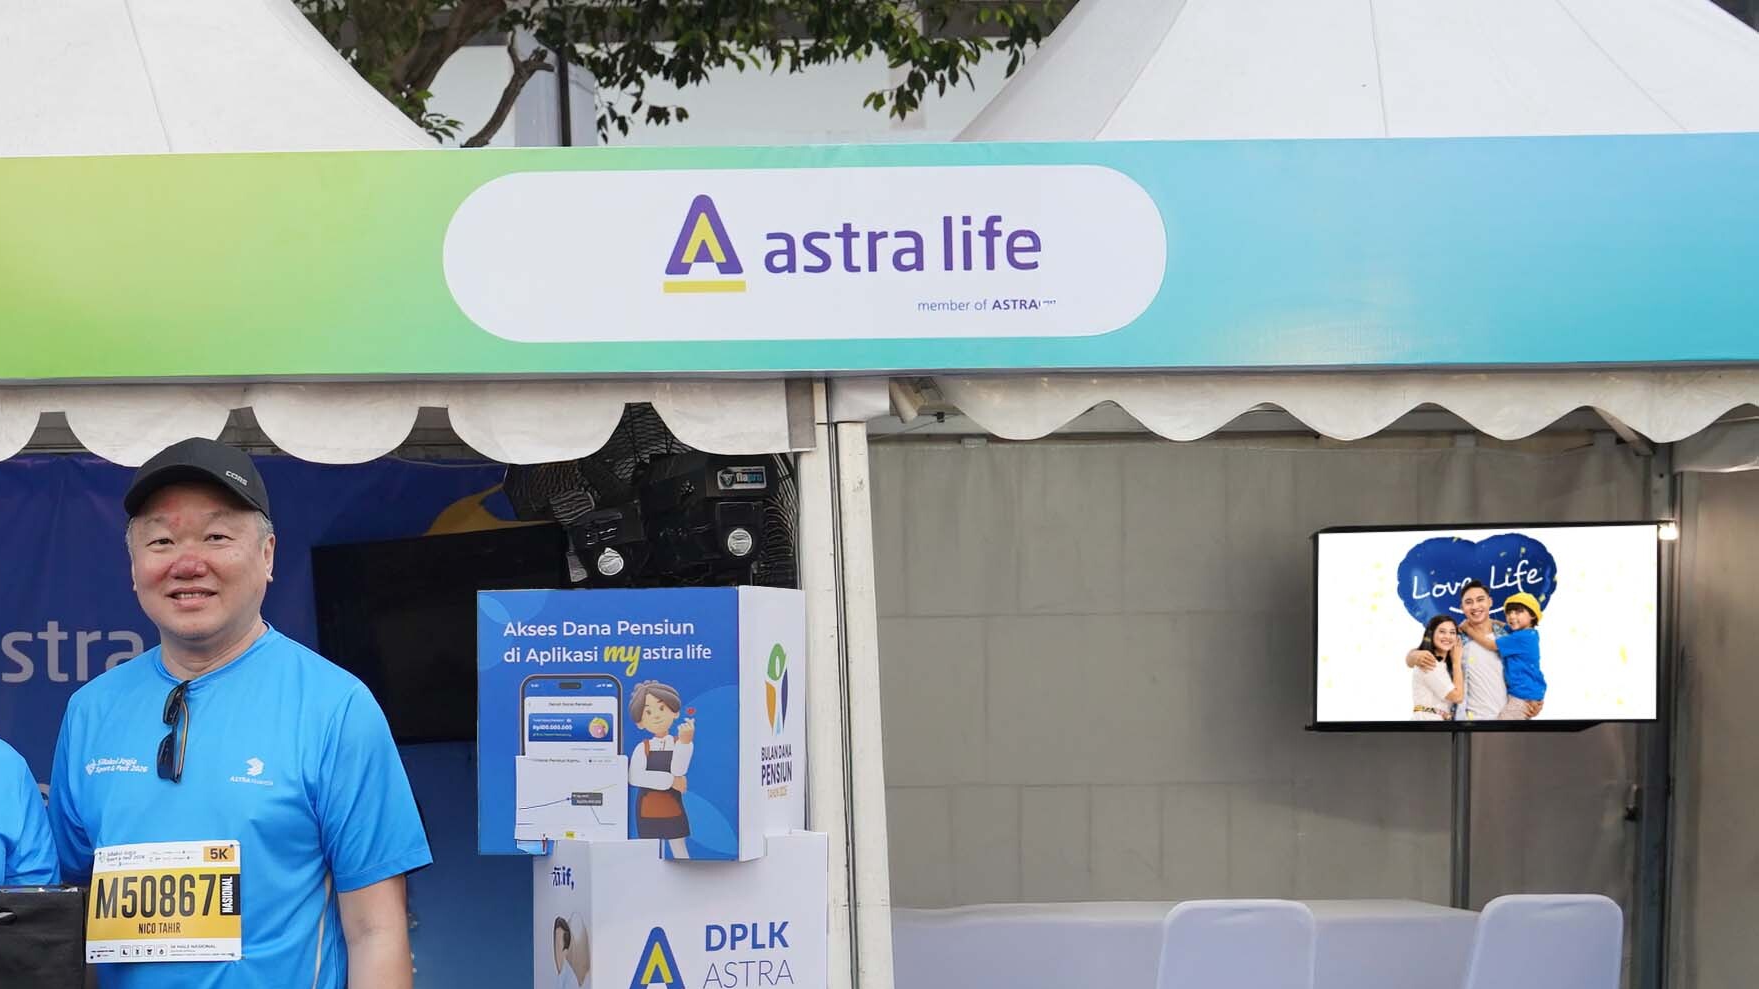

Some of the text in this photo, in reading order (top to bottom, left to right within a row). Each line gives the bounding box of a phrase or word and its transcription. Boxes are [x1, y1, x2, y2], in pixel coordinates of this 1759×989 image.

[764, 215, 1042, 273] astra life
[917, 299, 970, 311] member
[974, 298, 987, 311] of
[1490, 560, 1543, 592] Life
[503, 620, 694, 637] Akses Dana Pensiun
[503, 644, 712, 677] di Aplikasi my astra life
[762, 760, 792, 786] PENSIUN
[210, 848, 228, 859] 5K
[95, 874, 216, 919] M50867
[222, 876, 234, 913] NASIONAL
[139, 922, 181, 934] NICO TAHIR
[705, 921, 790, 952] DPLK
[703, 959, 794, 989] ASTRA
